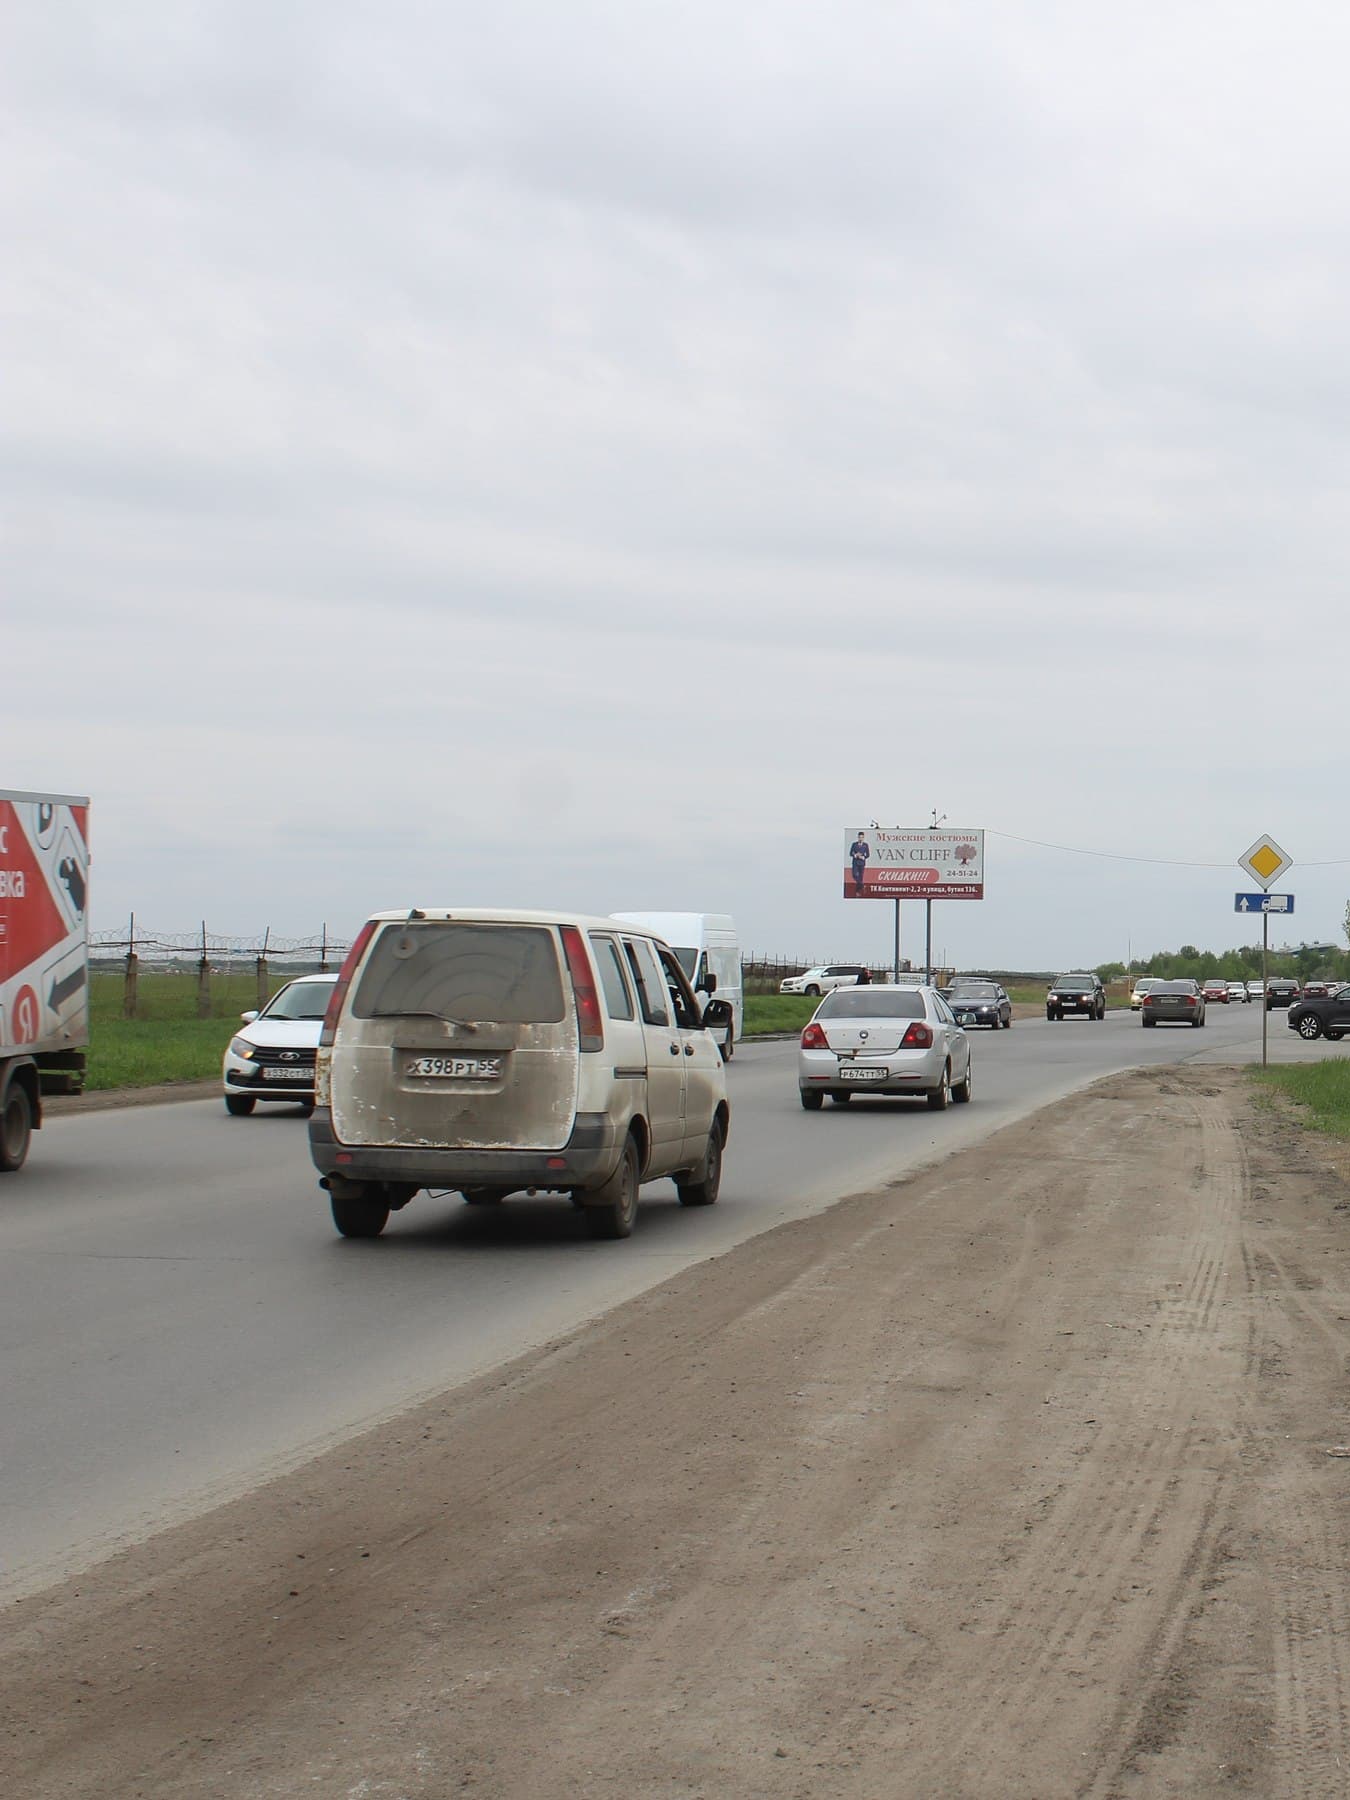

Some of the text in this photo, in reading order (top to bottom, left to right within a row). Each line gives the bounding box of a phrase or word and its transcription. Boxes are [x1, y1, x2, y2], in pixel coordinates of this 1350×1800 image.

[877, 833, 978, 843] Мужские костюмы
[876, 848, 951, 861] VAN CLIFF
[878, 871, 930, 881] СКИДКИ!!!
